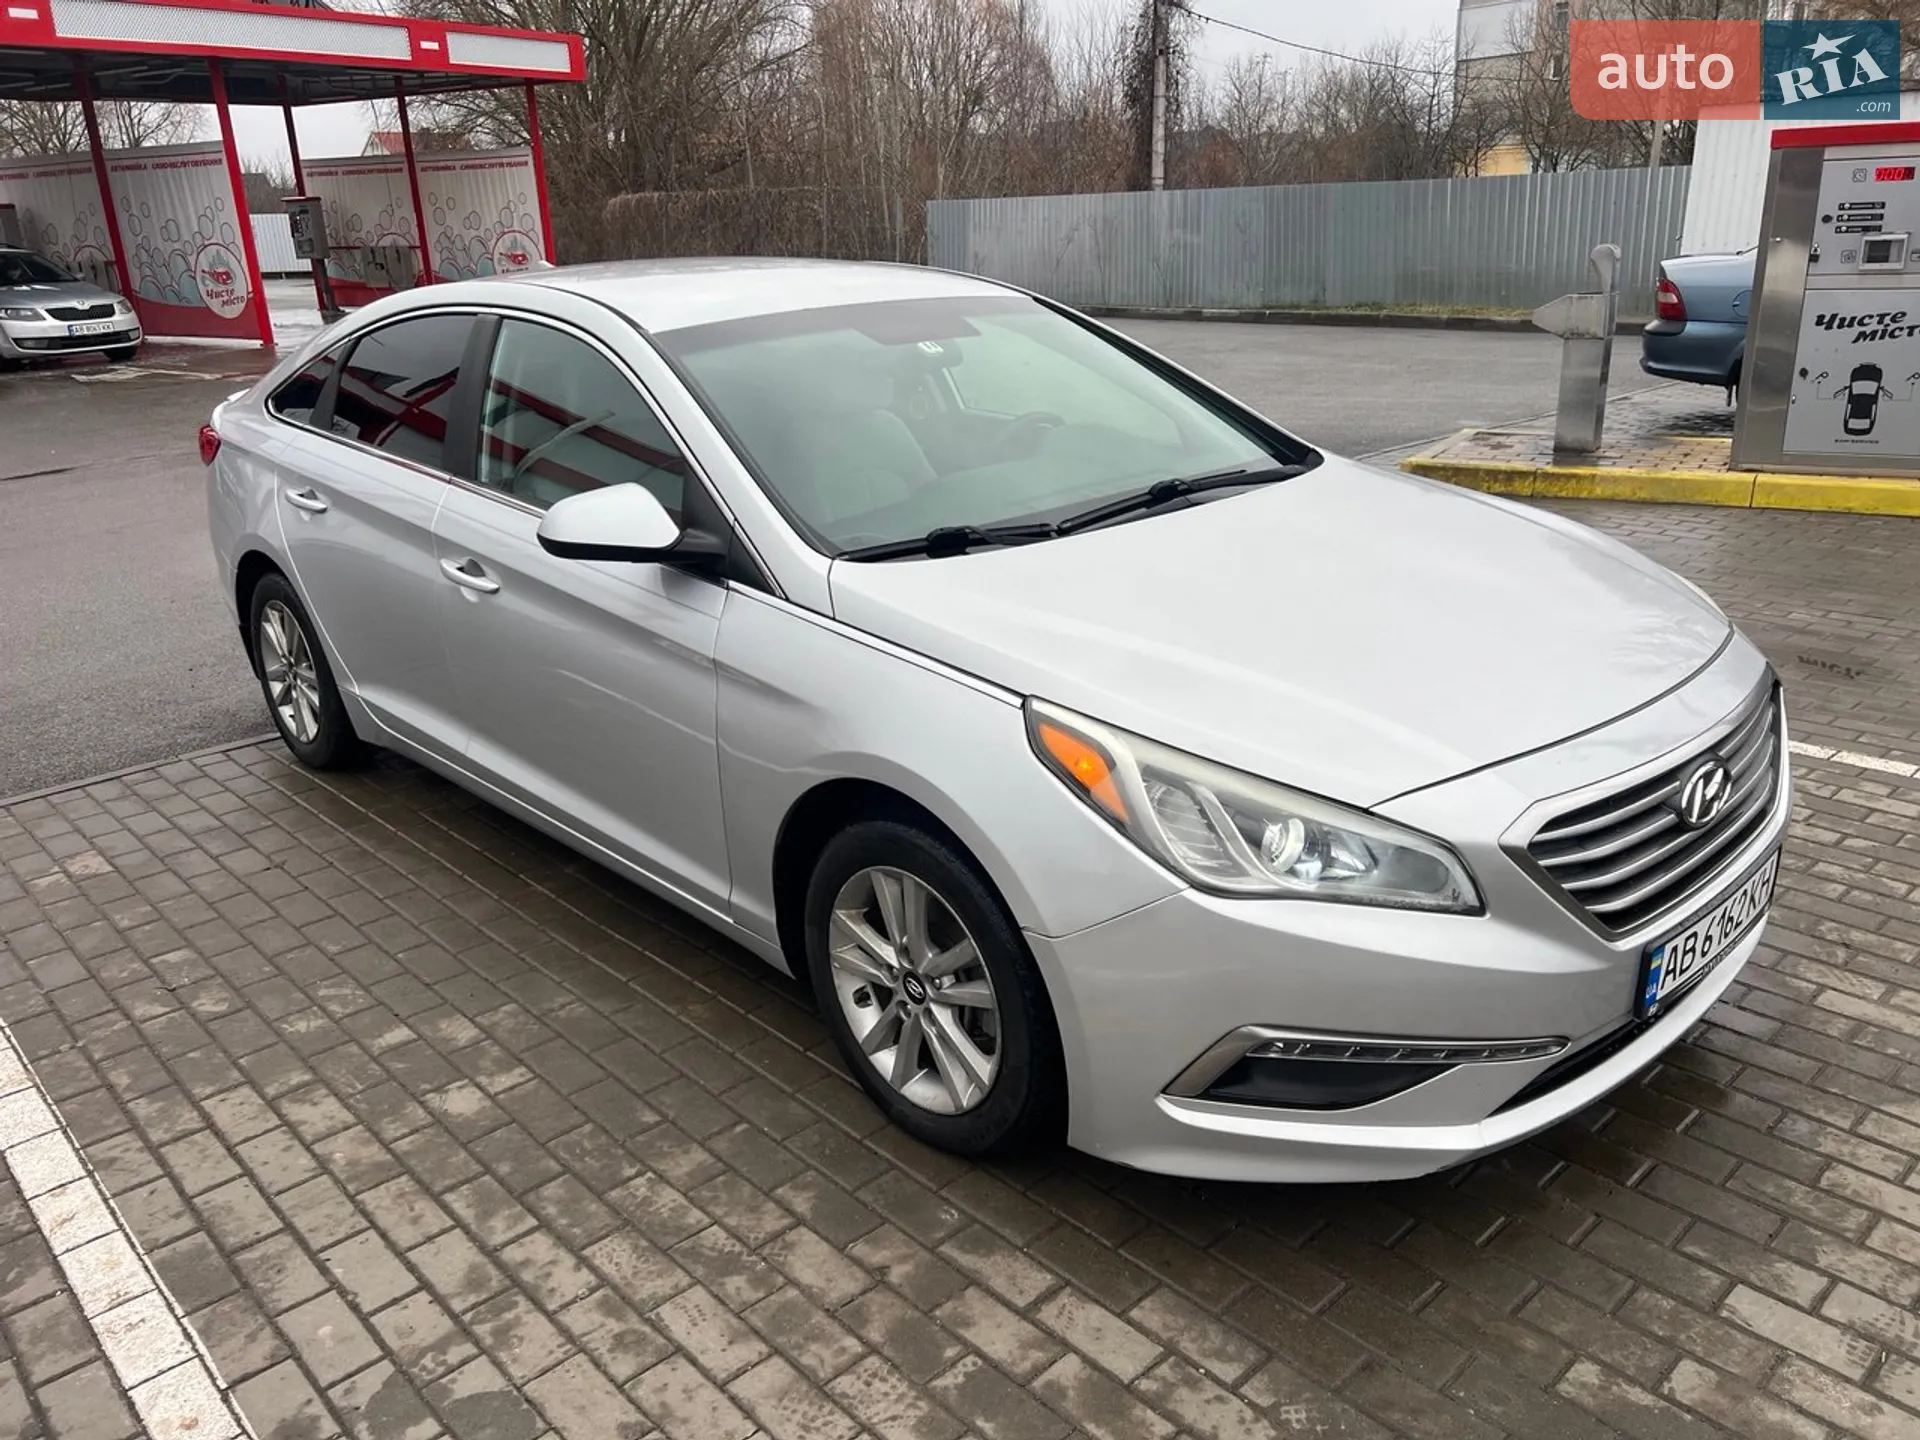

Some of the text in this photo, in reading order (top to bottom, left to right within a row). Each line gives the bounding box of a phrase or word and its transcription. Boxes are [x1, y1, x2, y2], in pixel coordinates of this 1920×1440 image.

[206, 288, 235, 300] Чисте
[1815, 311, 1907, 331] Чисте
[1851, 323, 1920, 344] міст
